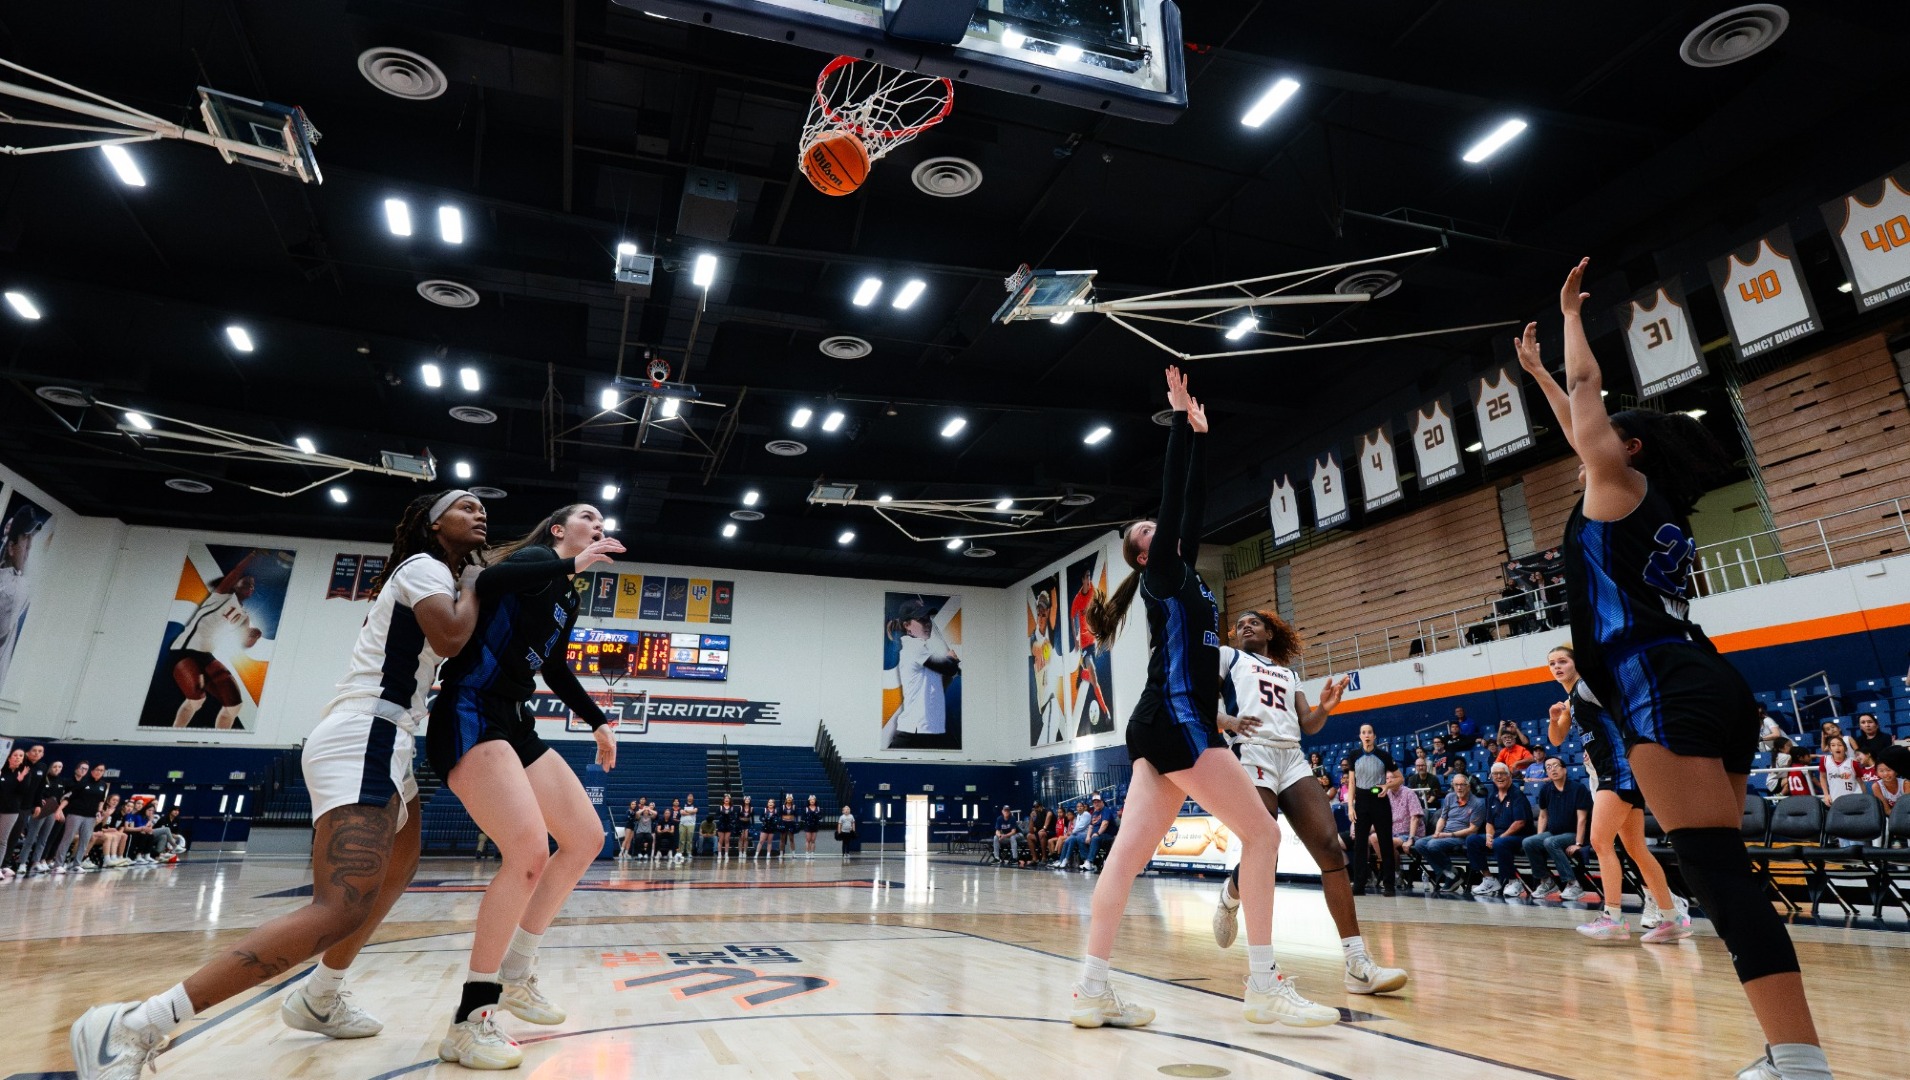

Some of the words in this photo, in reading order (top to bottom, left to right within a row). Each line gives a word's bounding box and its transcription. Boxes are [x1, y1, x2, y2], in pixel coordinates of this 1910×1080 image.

[813, 147, 843, 186] Wilson
[1860, 214, 1910, 253] 40
[1738, 269, 1782, 304] 40
[1863, 292, 1888, 307] GENIA
[1642, 317, 1673, 350] 31
[1741, 337, 1774, 358] NANCY
[1775, 320, 1815, 344] DUNKLE
[1643, 381, 1668, 397] CEDRIC
[1667, 365, 1703, 387] CEBALLOS
[1486, 392, 1512, 422] 25
[1423, 424, 1445, 450] 20
[1487, 446, 1508, 461] BRUCE
[1507, 437, 1531, 453] BOWEN
[1371, 452, 1382, 471] 4
[1322, 476, 1332, 494] 2
[1280, 496, 1286, 512] 1
[598, 578, 613, 598] F
[1349, 673, 1358, 690] K
[1258, 678, 1288, 713] 55
[632, 702, 750, 719] TERRITORY
[1788, 776, 1804, 791] 10
[1844, 782, 1853, 791] 15
